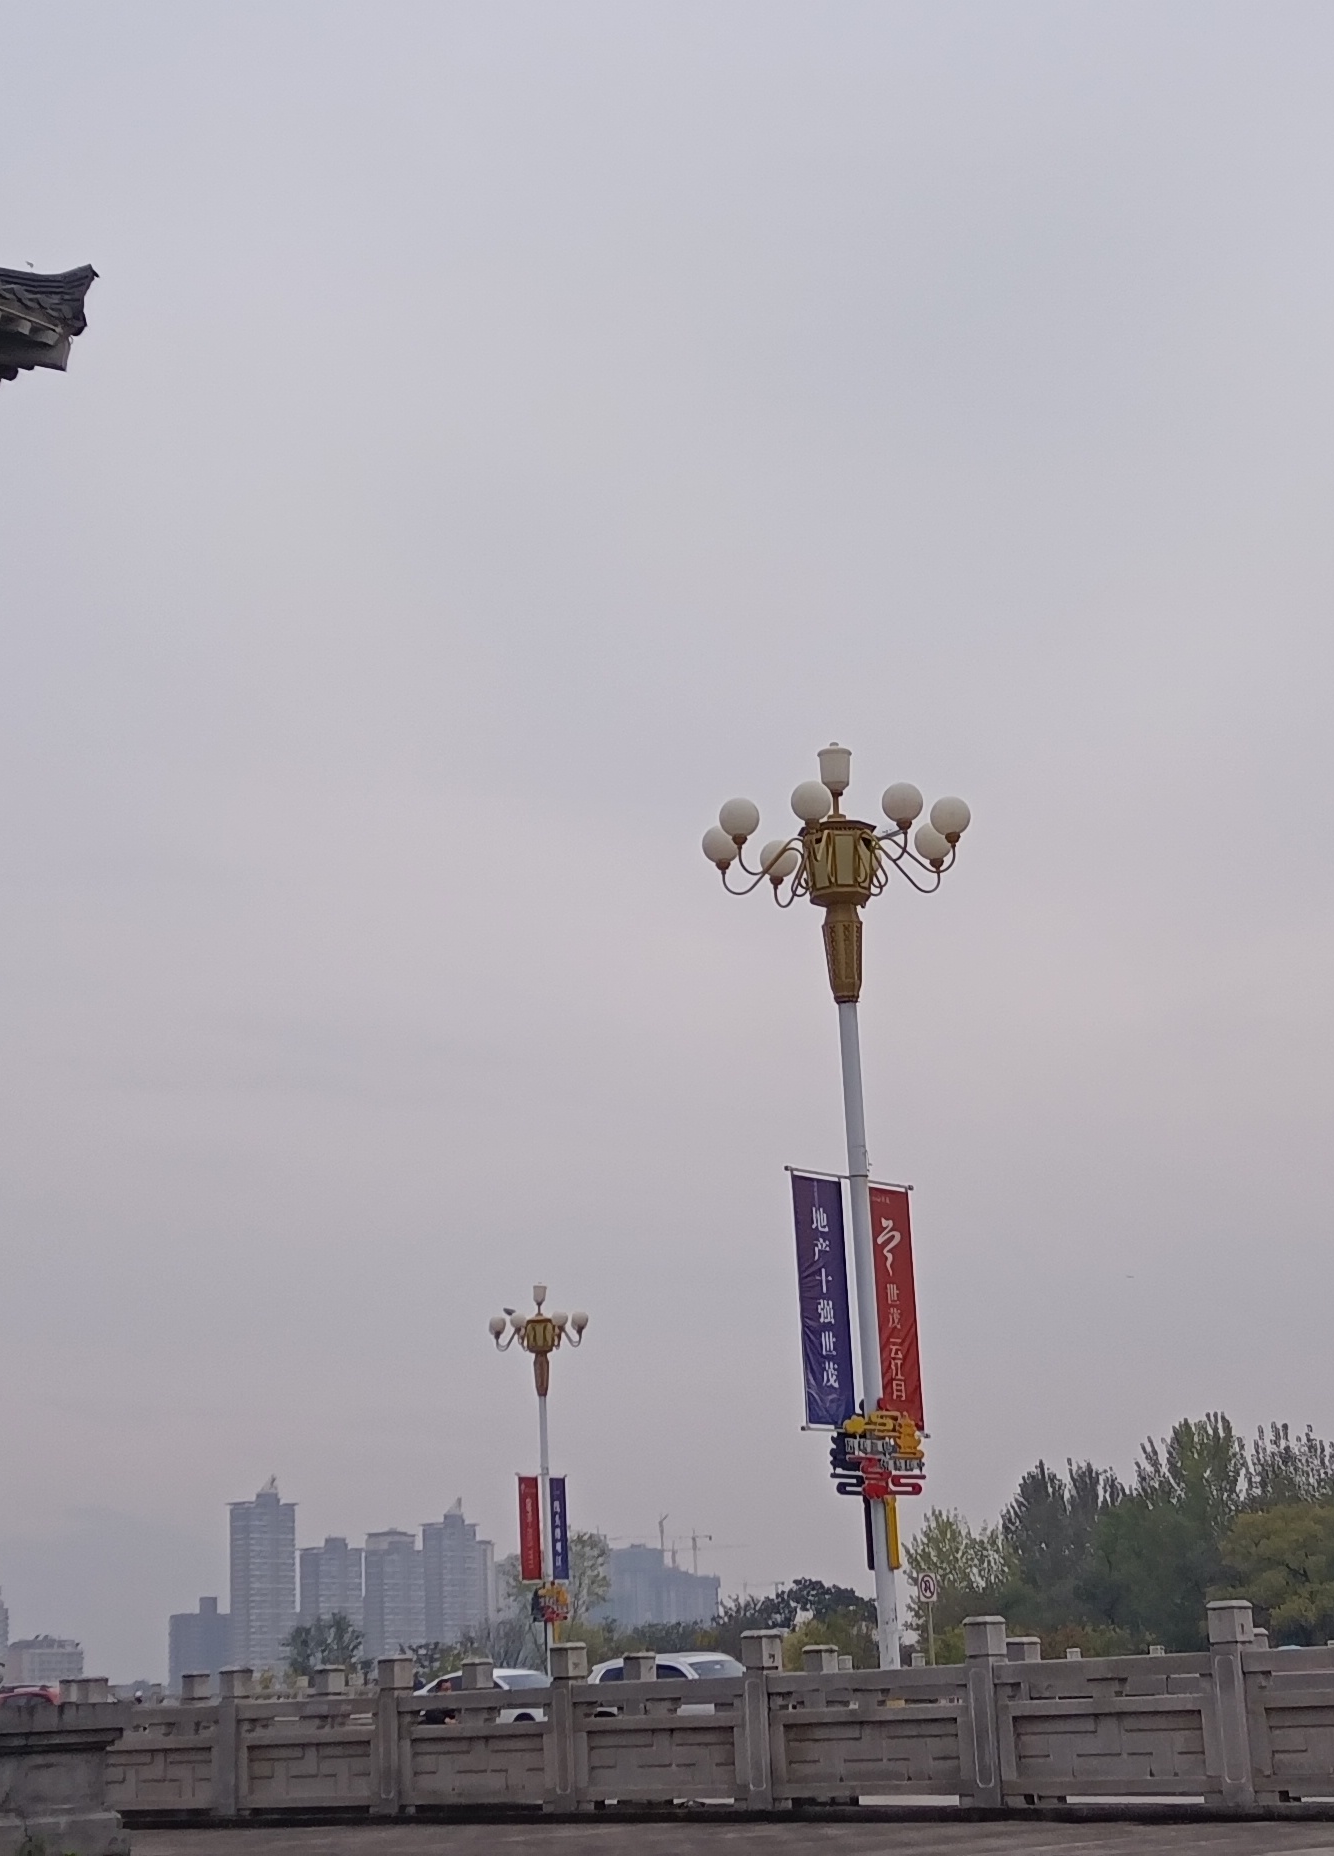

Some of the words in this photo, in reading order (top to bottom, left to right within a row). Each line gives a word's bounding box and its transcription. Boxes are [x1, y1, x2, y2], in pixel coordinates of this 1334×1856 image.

[811, 1206, 840, 1389] 地产十强世茂
